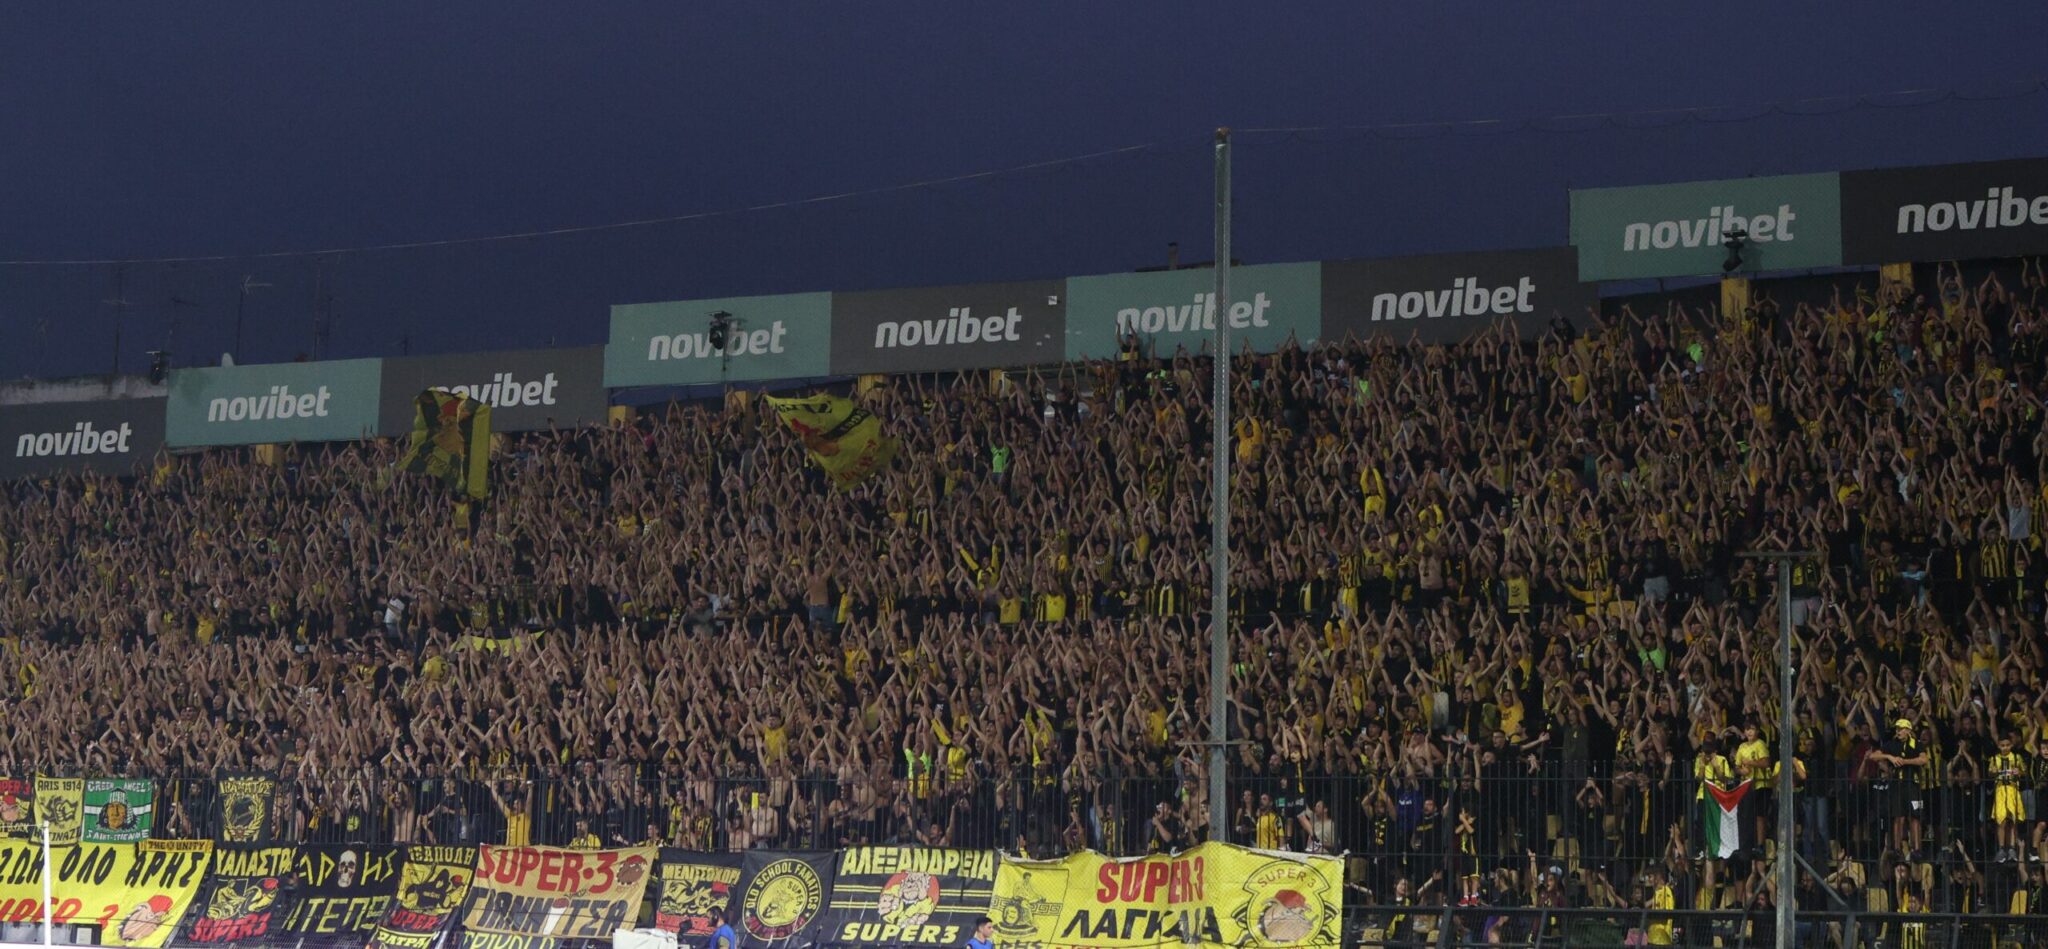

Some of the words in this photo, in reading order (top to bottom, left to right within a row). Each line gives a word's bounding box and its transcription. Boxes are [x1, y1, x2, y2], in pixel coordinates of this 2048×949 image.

[1623, 203, 1796, 252] novibet
[1371, 275, 1536, 321] novibet
[648, 320, 787, 361] novbet
[874, 306, 1023, 349] novibet
[208, 384, 331, 423] novibet
[428, 372, 559, 409] vibet
[16, 421, 132, 457] novibet
[37, 781, 59, 792] ARIS
[62, 780, 82, 791] 1914
[148, 840, 166, 850] THE
[176, 840, 206, 851] UNITY
[214, 848, 297, 877] ΧΑΛΑΣΤΡ
[840, 846, 994, 882] ΑΛΕΞΑΝΔΡΕΙΑ
[59, 845, 117, 886] ΟΛΟ
[125, 850, 205, 889] ΑΡΗΣ
[1257, 868, 1306, 889] SUPER
[1307, 878, 1317, 889] 3
[746, 888, 760, 909] OLD
[756, 862, 793, 888] SCHOOL
[794, 863, 821, 911] FANATICS
[96, 903, 119, 929] 3
